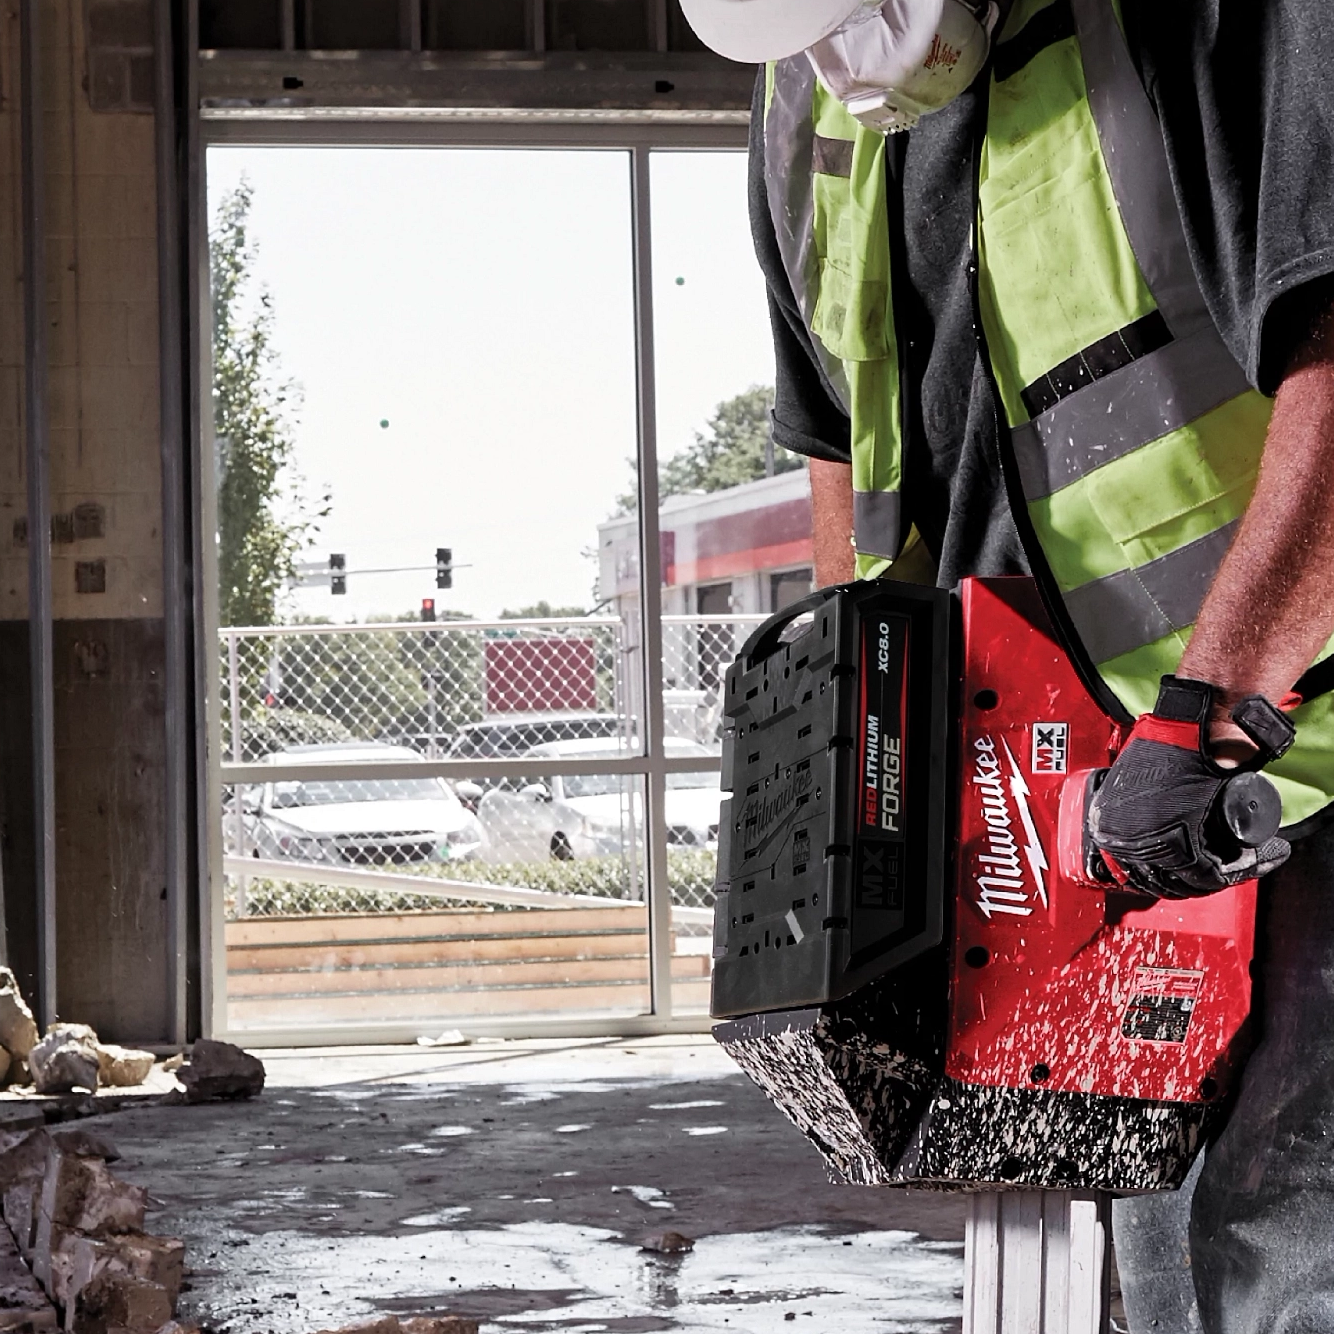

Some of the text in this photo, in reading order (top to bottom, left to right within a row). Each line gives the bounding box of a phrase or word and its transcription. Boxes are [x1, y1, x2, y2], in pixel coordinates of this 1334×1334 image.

[878, 622, 890, 674] XC8.0
[866, 714, 879, 827] REDLITHIUM
[1037, 727, 1054, 771] MX
[1055, 726, 1065, 771] FUEL
[741, 769, 813, 849] Milwaukee
[881, 733, 901, 832] FORGE
[973, 733, 1034, 919] Milwaukee
[861, 845, 884, 905] MX
[887, 846, 899, 905] FUEL
